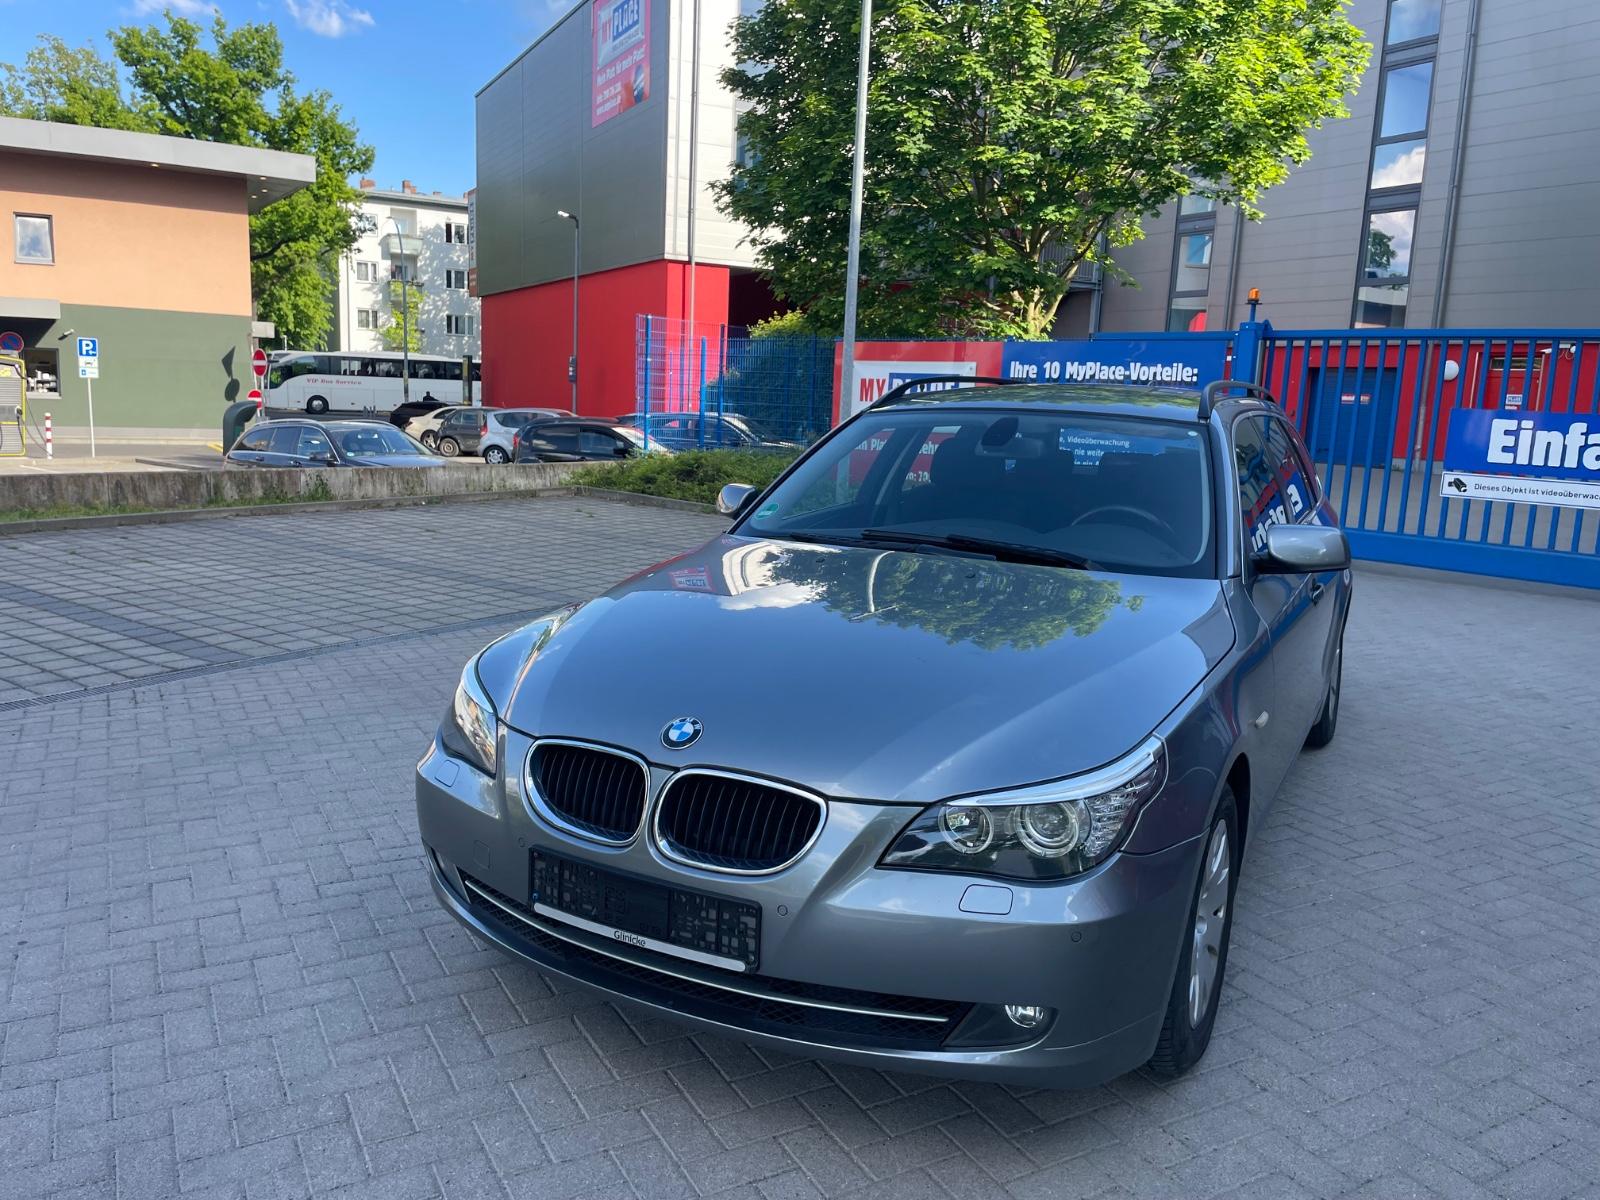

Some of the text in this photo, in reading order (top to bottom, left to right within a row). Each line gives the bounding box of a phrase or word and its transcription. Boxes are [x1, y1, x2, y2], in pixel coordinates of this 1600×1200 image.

[1010, 361, 1199, 382] Ihre 10 MyPlace-Vorteile:
[860, 378, 886, 402] MY
[1067, 435, 1130, 448] Videoüberwachung
[1486, 418, 1600, 470] Einfa
[1474, 483, 1600, 500] Dieses Objekt ist videoüberwac
[613, 930, 646, 947] Glinicke
